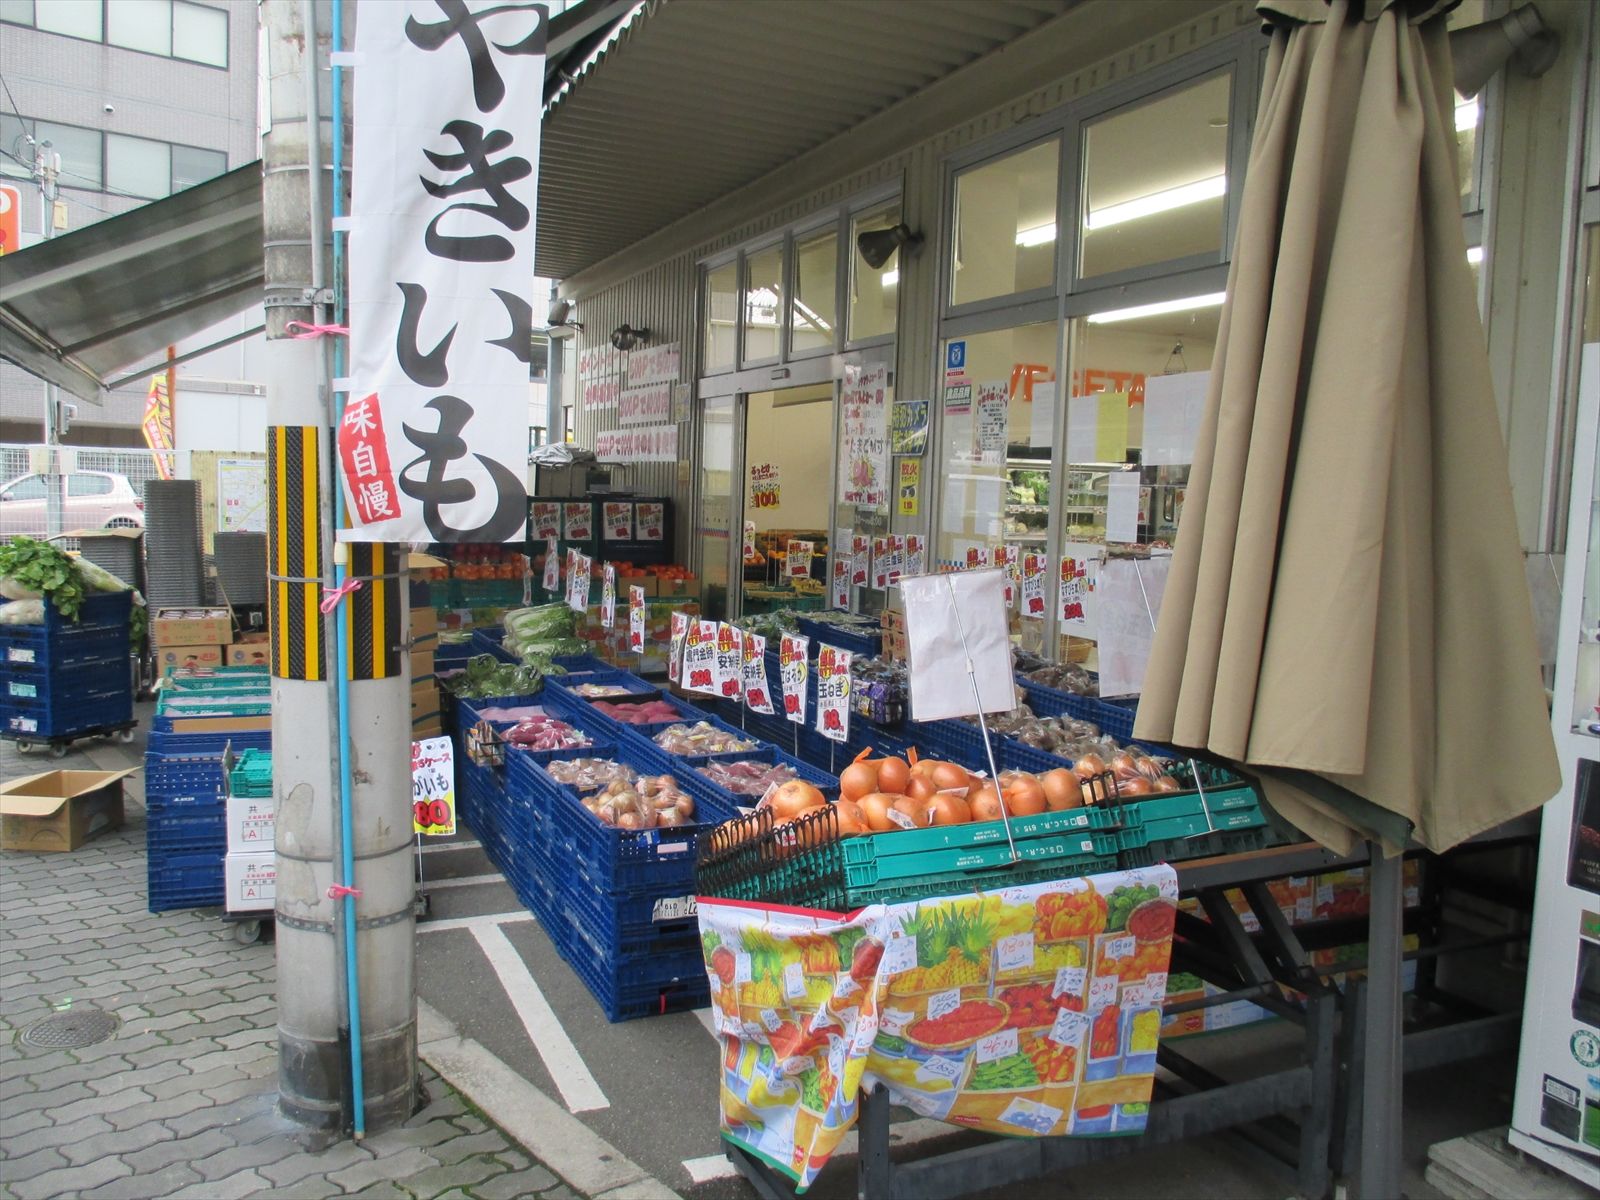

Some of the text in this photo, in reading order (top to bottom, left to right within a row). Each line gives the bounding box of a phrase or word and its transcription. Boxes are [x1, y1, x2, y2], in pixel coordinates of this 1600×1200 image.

[396, 0, 549, 543] やきいも
[343, 393, 392, 522] 味自慢
[818, 681, 844, 699] 玉ねぎ
[248, 829, 257, 839] A
[247, 887, 256, 897] A
